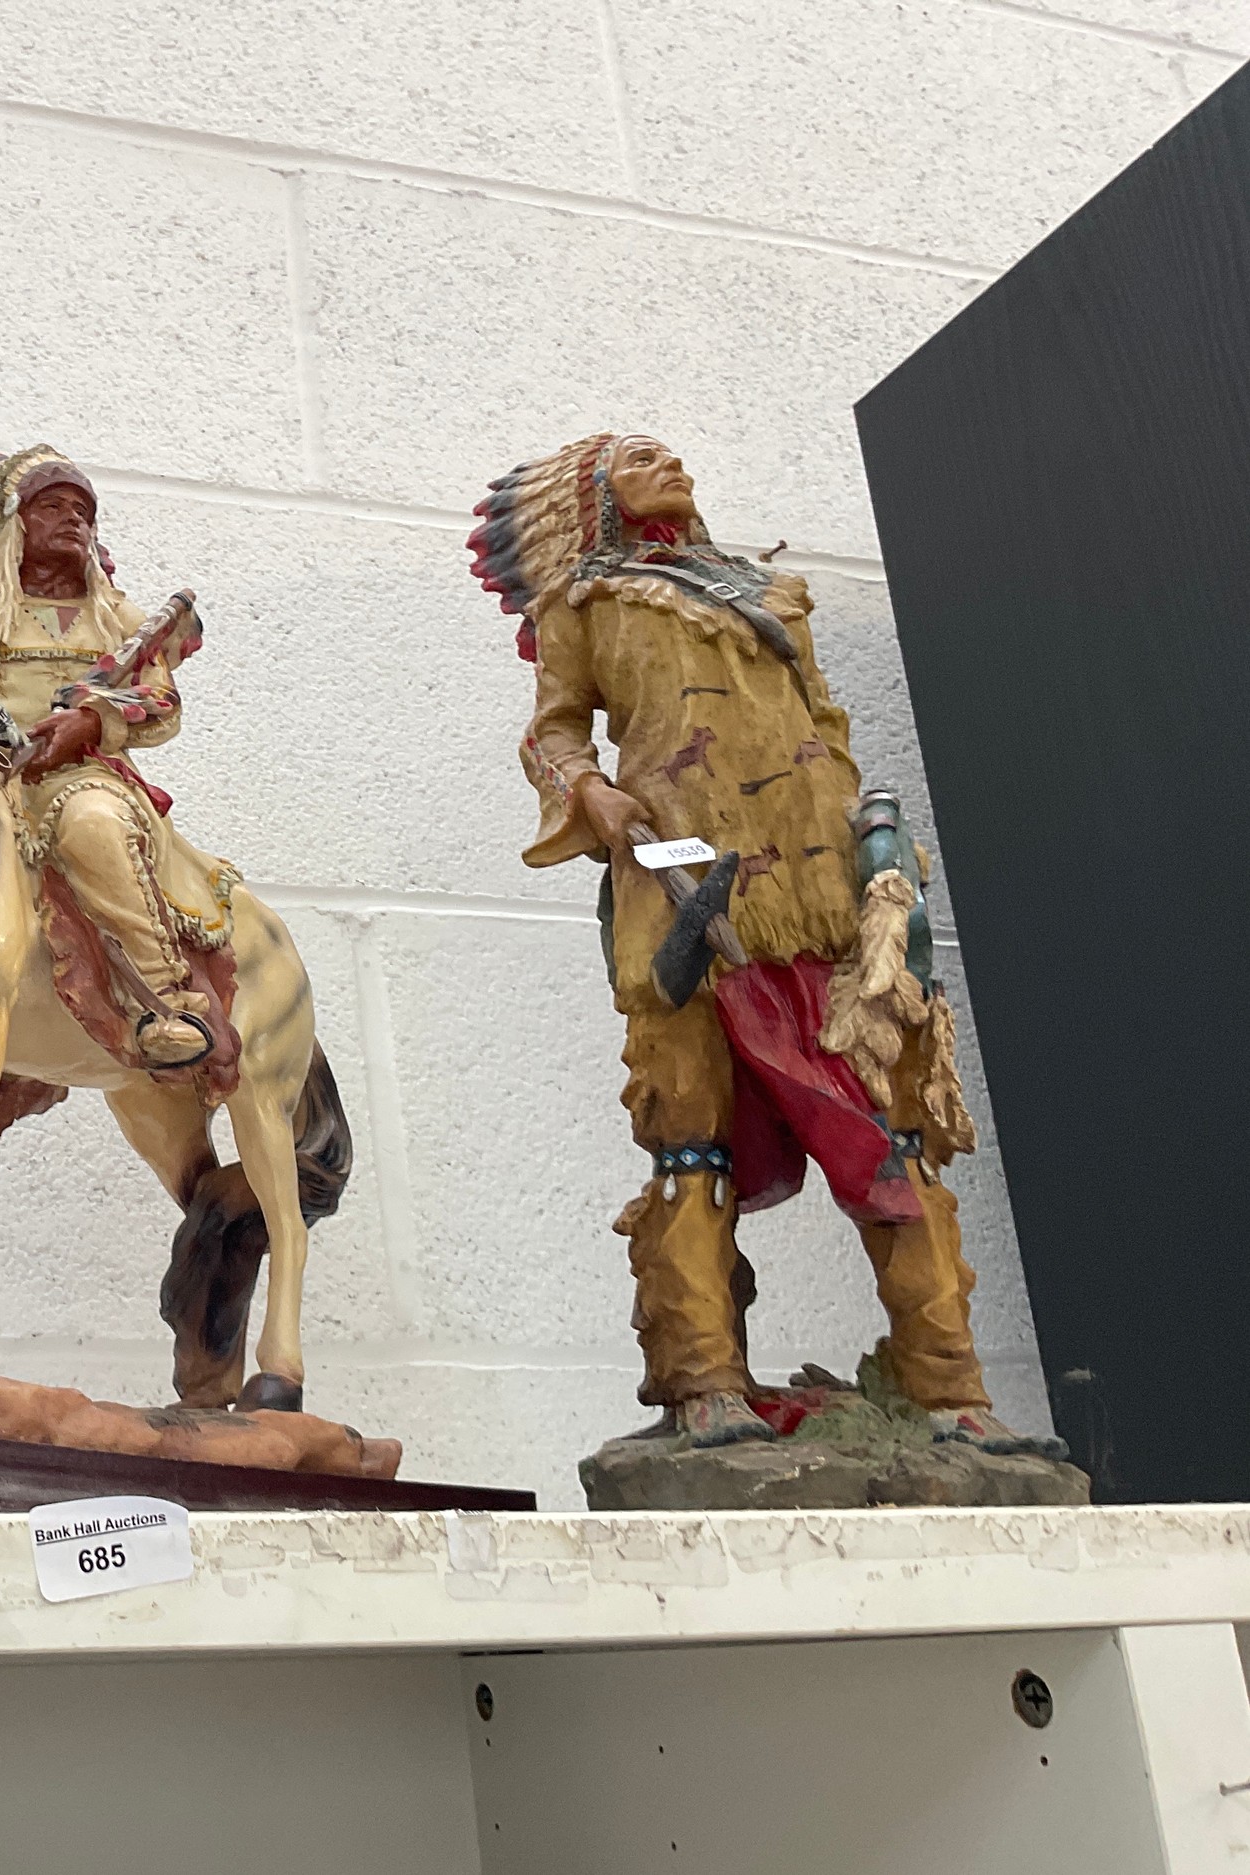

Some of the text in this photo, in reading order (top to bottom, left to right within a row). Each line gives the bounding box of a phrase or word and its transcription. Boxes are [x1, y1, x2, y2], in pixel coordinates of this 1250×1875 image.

[667, 844, 707, 859] 15539
[34, 1512, 167, 1543] Bank Hall Auctions
[78, 1543, 126, 1574] 685
